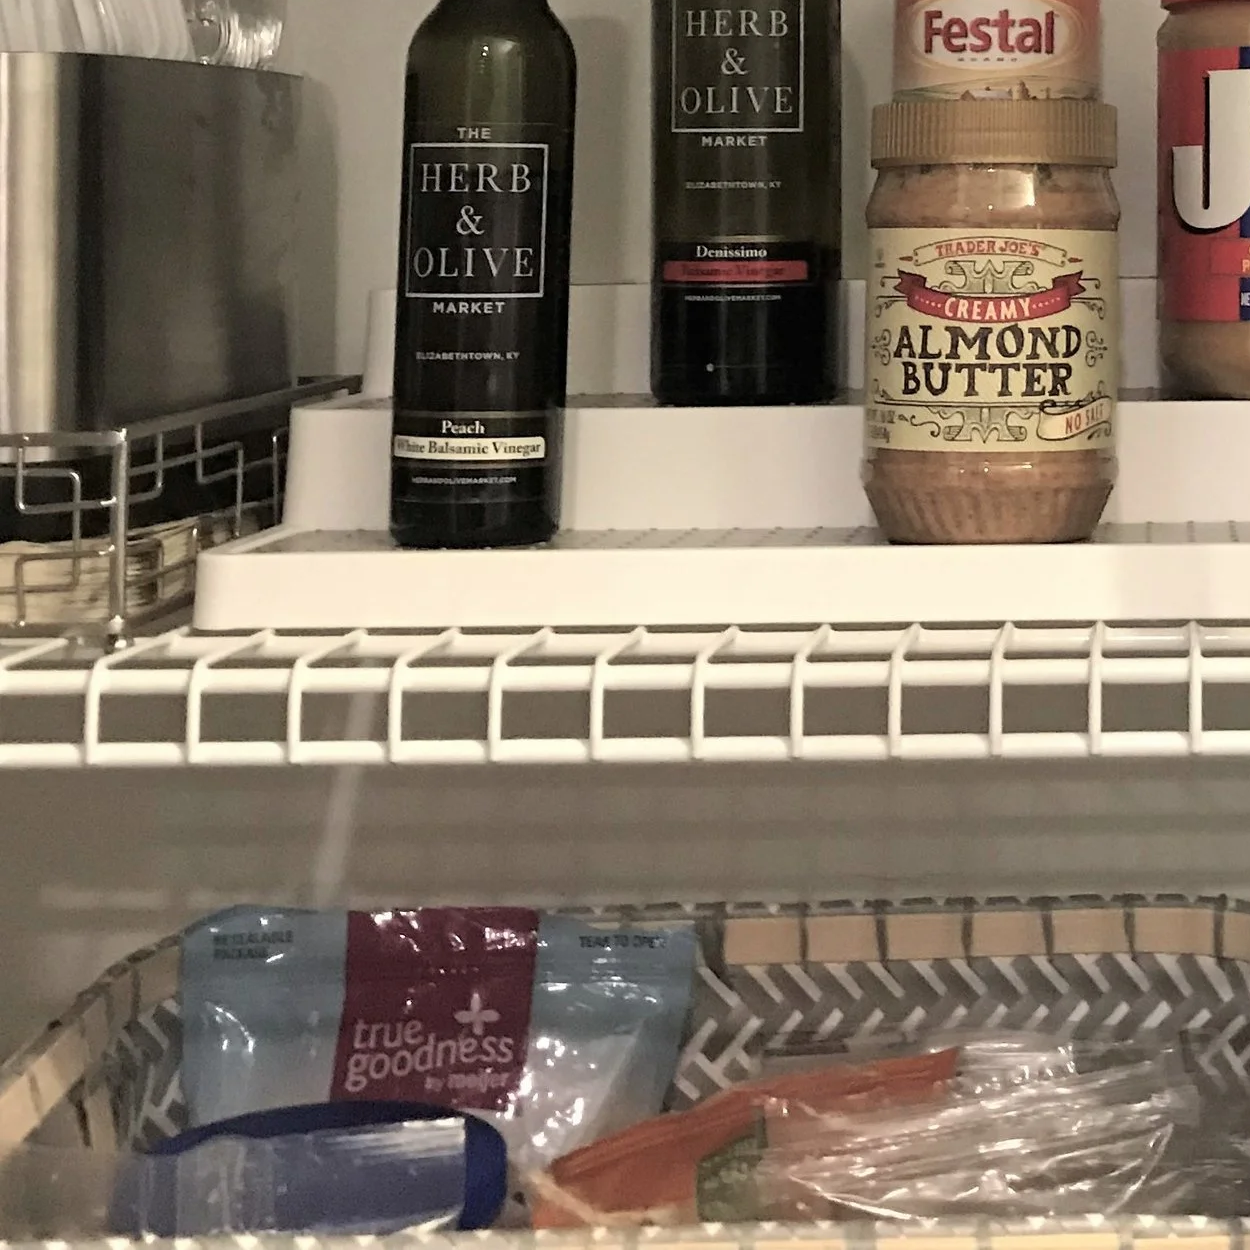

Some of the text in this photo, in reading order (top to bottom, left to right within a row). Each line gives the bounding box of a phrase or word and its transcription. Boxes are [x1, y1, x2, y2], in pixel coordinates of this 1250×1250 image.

[686, 9, 789, 37] HERB
[924, 8, 1055, 55] Festal
[720, 47, 749, 75] &
[680, 86, 793, 115] OLIVE
[456, 127, 492, 139] THE
[701, 135, 768, 147] MARKET
[421, 163, 532, 193] HERB
[456, 205, 485, 236] &
[413, 246, 534, 278] OLIVE
[696, 245, 768, 259] Denissimo
[935, 240, 1041, 258] TRADER JOE'S
[433, 301, 506, 314] MARKET
[944, 297, 1031, 321] CREAMY
[893, 323, 1082, 361] ALMOND
[902, 361, 1072, 398] BUTTER
[441, 420, 486, 435] Peach
[1065, 418, 1082, 435] NO
[428, 440, 489, 455] Balsamic
[492, 441, 541, 457] Vinegar
[353, 1017, 425, 1049] true
[344, 1033, 514, 1093] goodness
